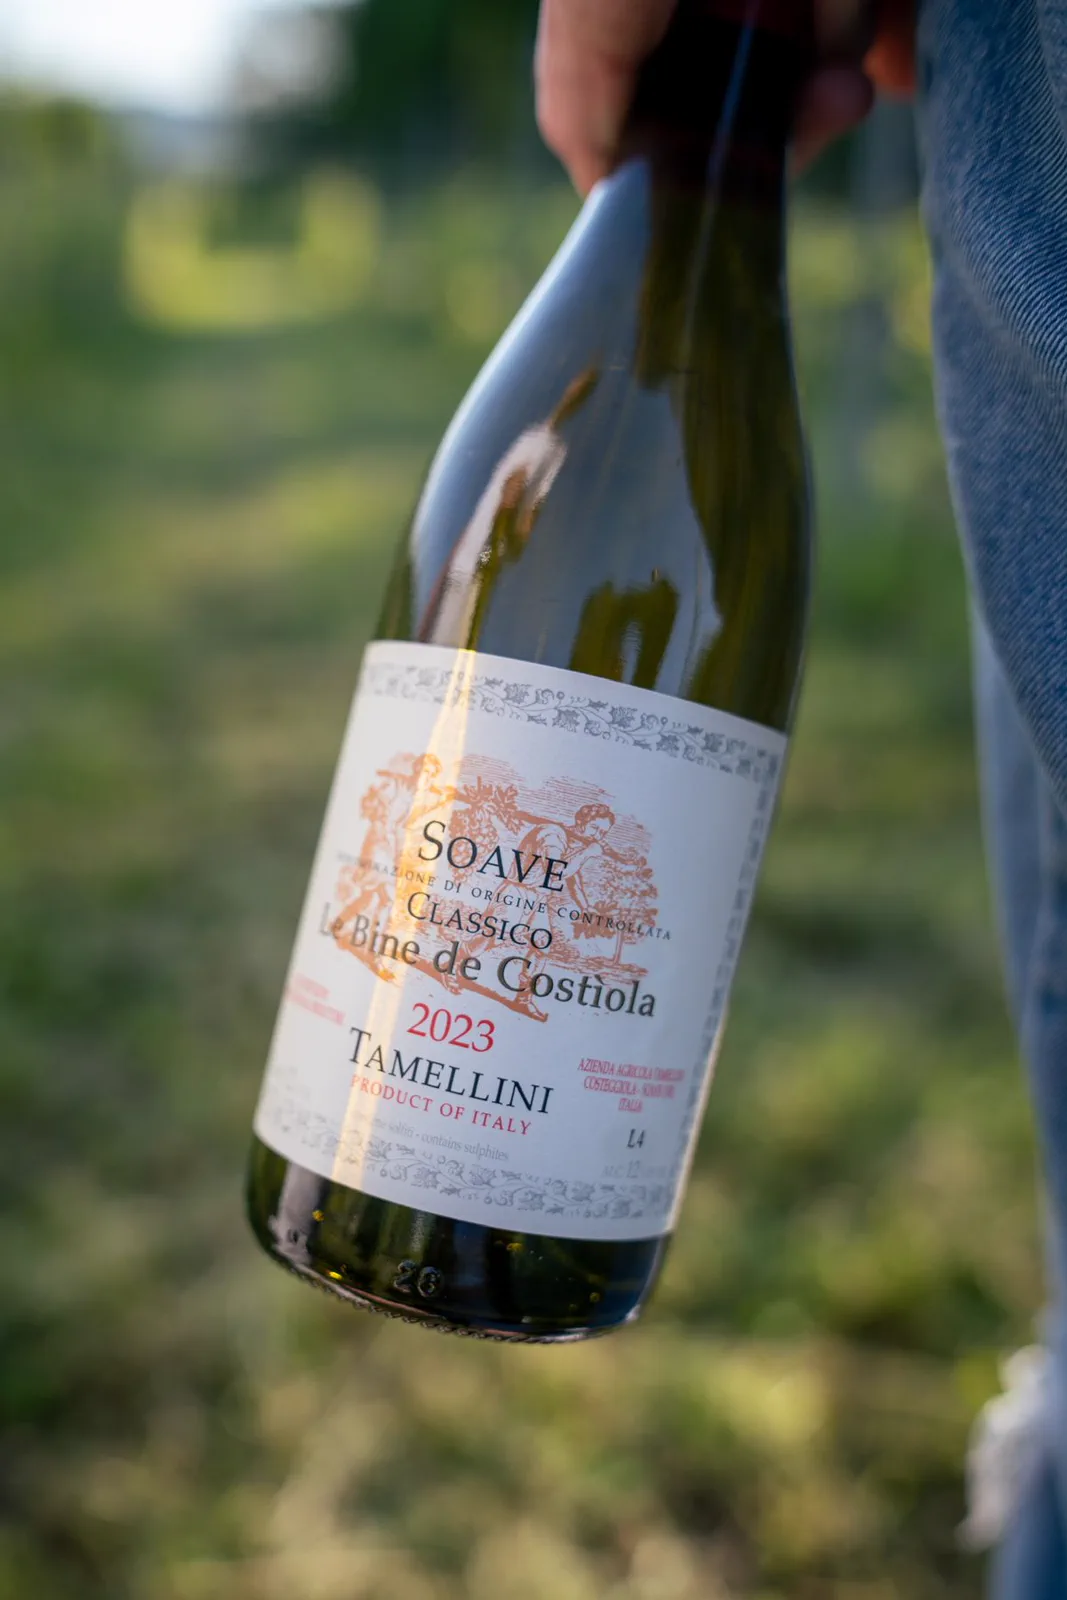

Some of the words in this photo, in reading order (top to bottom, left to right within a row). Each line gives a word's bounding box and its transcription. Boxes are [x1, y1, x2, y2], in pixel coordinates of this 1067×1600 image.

[418, 820, 568, 892] SOAVE
[407, 892, 553, 950] CLASSICO
[444, 879, 461, 893] DI
[471, 887, 547, 914] ORIGINE
[557, 907, 672, 940] CONTROLLATA
[350, 914, 420, 965] Bine
[433, 941, 482, 981] de
[407, 1002, 495, 1052] 2023
[348, 1027, 554, 1114] TAMELLINI
[577, 1058, 615, 1075] AZIENDA
[350, 1074, 433, 1112] PRODUCT
[439, 1102, 465, 1120] OF
[472, 1110, 532, 1136] ITALY
[421, 1132, 463, 1150] contains
[464, 1142, 510, 1162] sulphites
[626, 1128, 645, 1148] L4
